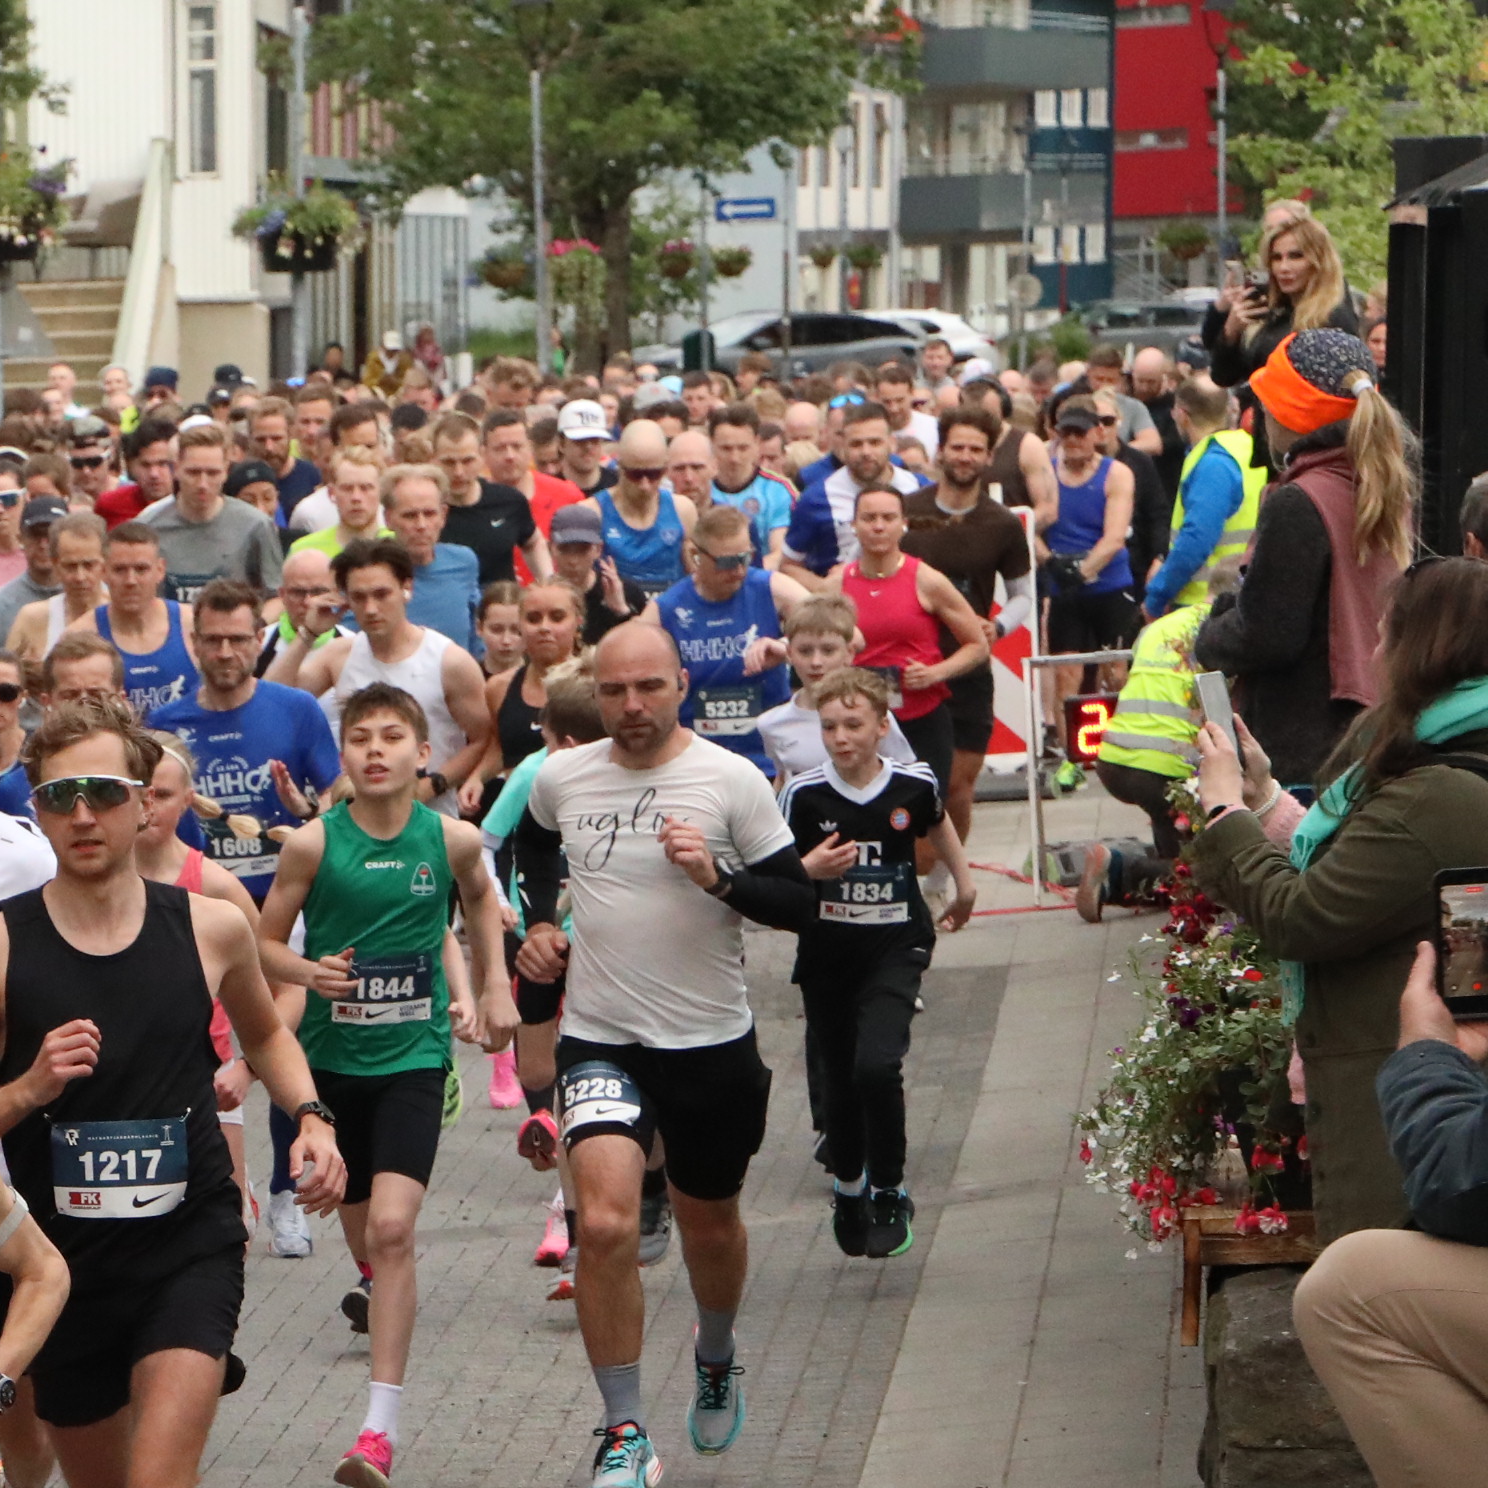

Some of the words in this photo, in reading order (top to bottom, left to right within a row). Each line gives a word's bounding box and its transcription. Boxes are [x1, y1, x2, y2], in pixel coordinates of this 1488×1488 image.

[704, 700, 750, 718] 5232
[365, 861, 397, 869] CRAFT
[840, 882, 894, 902] 1834
[357, 975, 415, 1000] 1844
[565, 1077, 622, 1107] 5228
[78, 1149, 163, 1182] 1217
